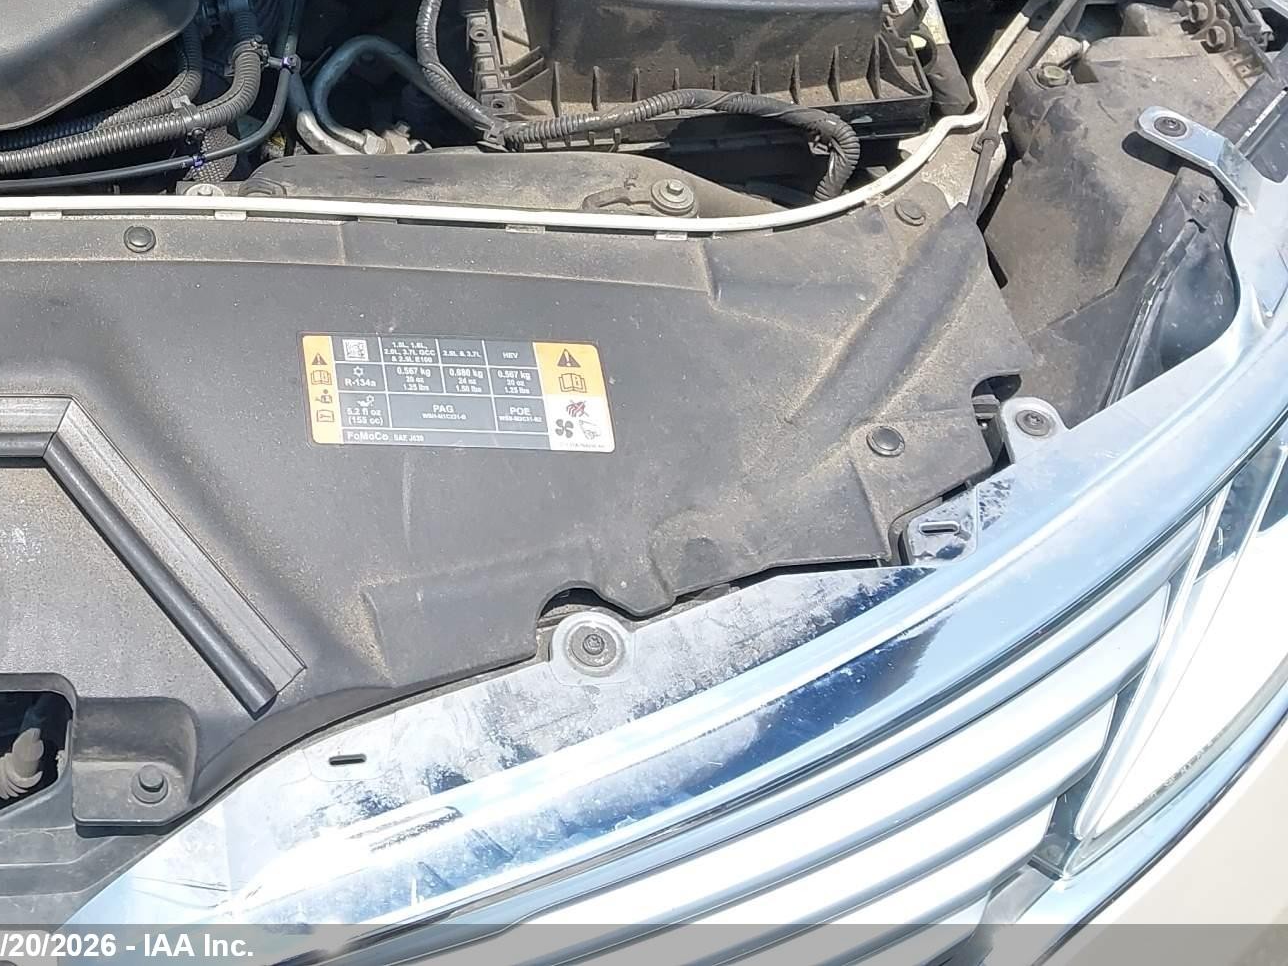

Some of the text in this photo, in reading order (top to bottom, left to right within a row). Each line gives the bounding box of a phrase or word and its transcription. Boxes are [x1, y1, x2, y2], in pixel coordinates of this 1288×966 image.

[420, 367, 431, 377] kg
[473, 369, 483, 378] kg
[520, 371, 531, 380] kg
[345, 379, 376, 387] R-134a
[433, 404, 454, 413] PAG
[510, 407, 531, 416] POE
[346, 431, 389, 440] FoMoCo
